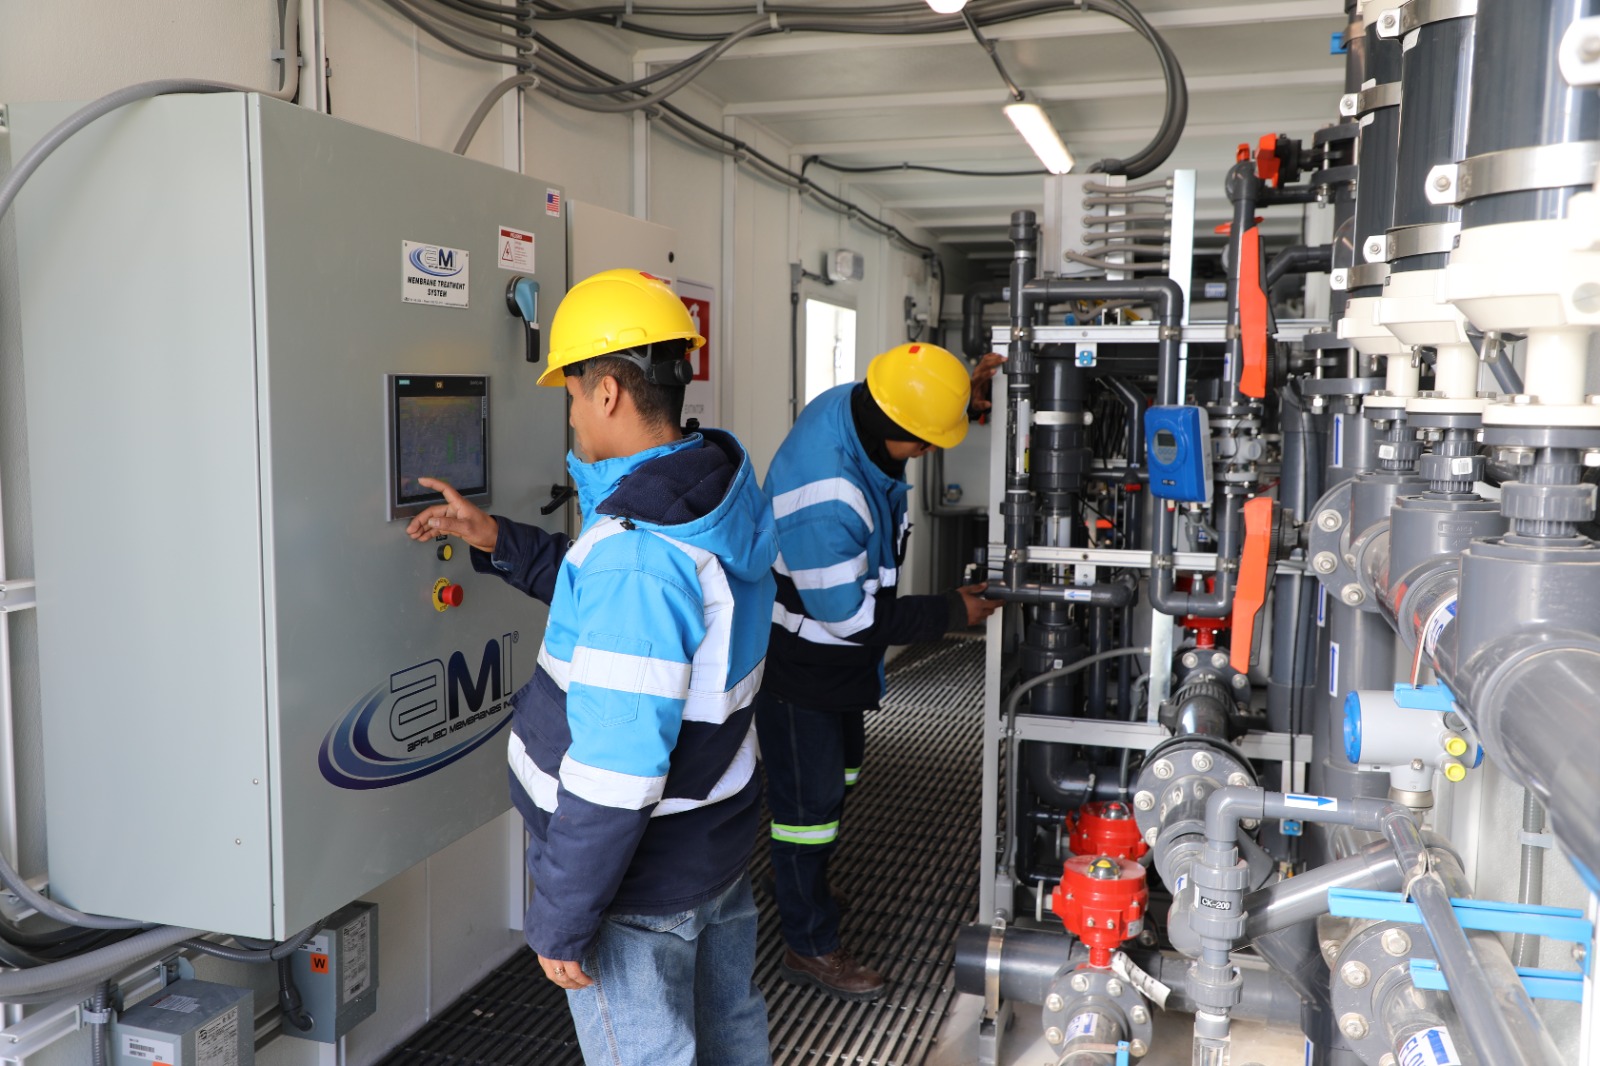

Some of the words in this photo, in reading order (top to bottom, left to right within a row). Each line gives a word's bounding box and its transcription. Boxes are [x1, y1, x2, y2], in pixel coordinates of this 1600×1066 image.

[407, 276, 437, 287] MEMBRANE
[438, 280, 466, 290] TREATMENT
[427, 288, 448, 298] SYSTEM
[1201, 898, 1231, 910] CK-200
[313, 958, 326, 969] W
